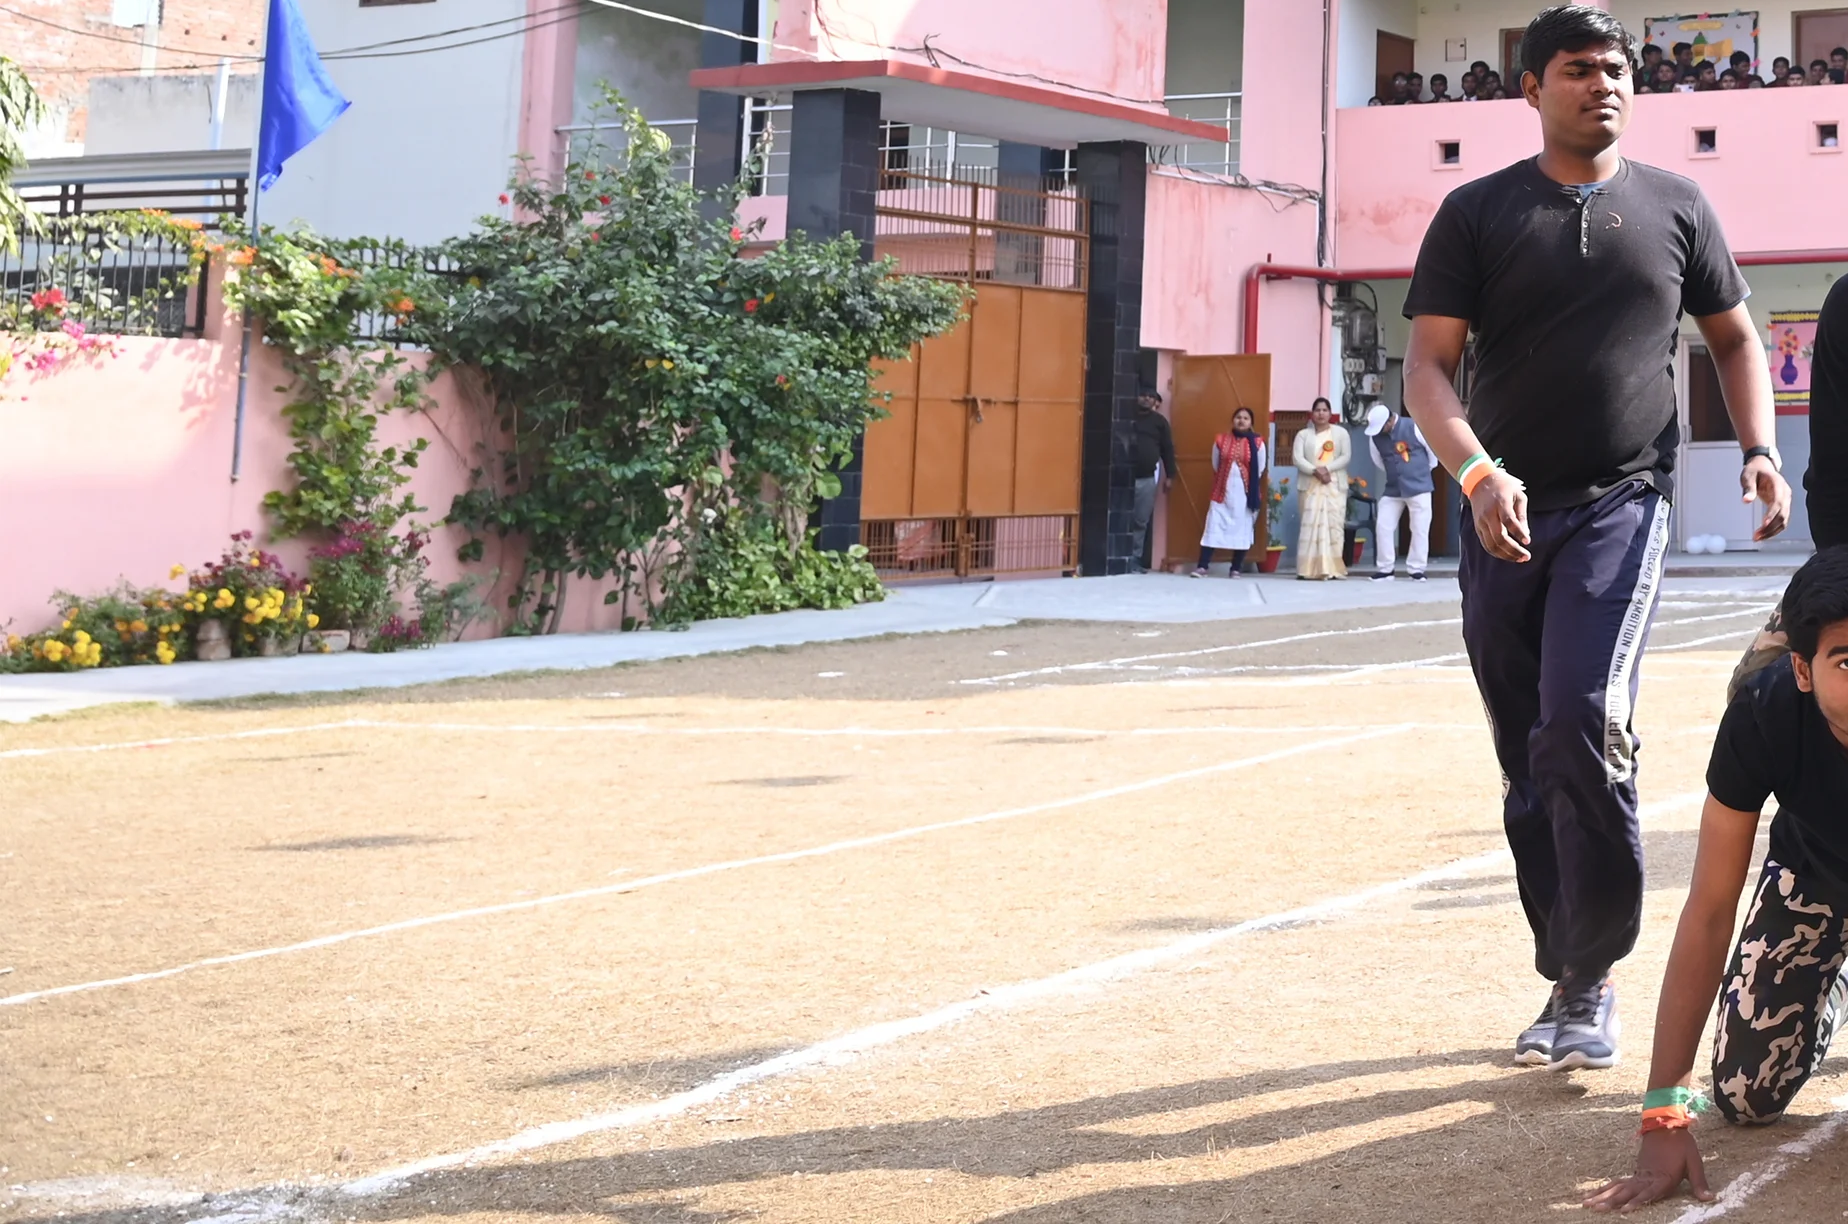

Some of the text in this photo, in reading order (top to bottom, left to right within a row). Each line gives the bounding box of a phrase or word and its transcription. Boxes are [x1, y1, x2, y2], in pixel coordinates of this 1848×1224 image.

[1639, 583, 1651, 596] BY
[1621, 599, 1644, 648] AMBITION
[1611, 652, 1627, 688] NIMES
